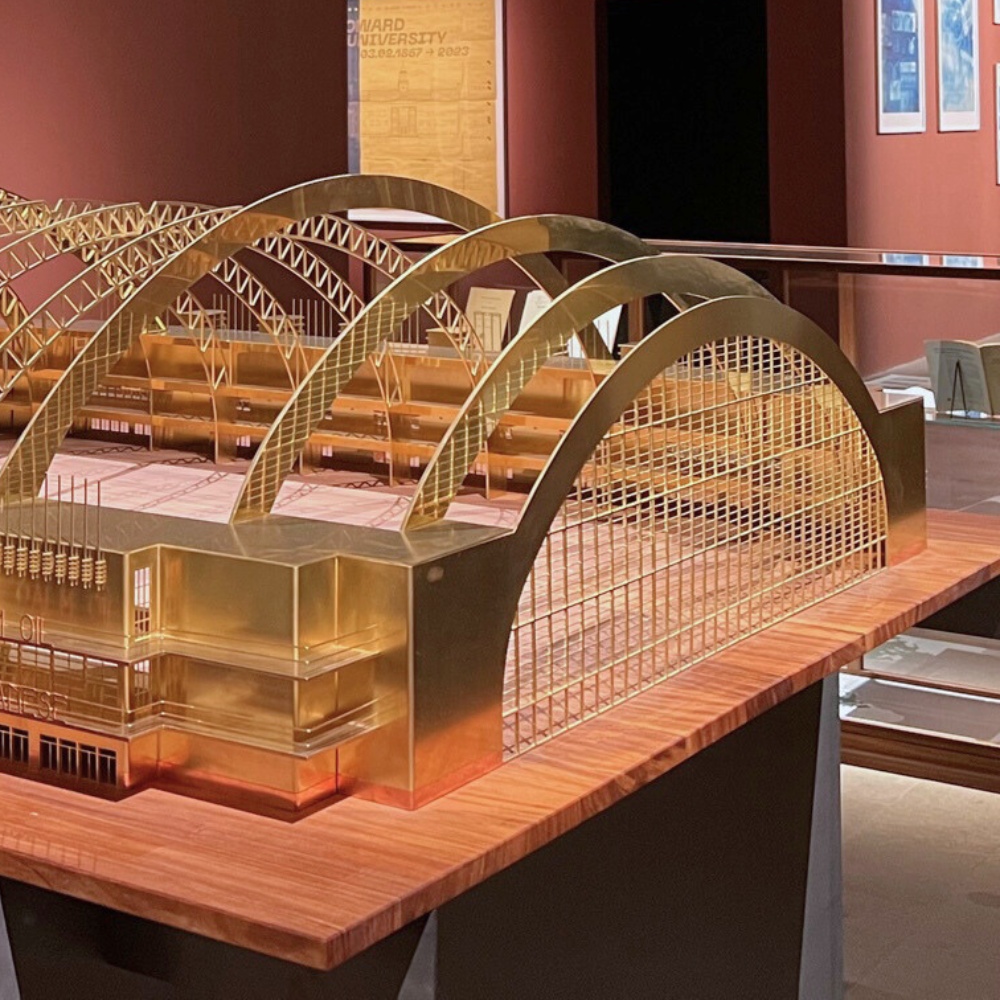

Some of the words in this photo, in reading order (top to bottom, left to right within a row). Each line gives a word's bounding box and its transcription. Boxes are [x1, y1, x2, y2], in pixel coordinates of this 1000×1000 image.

[347, 18, 405, 33] OWARD
[347, 31, 447, 47] UNIVERSITY
[438, 46, 470, 57] 2023
[19, 613, 52, 647] OIL
